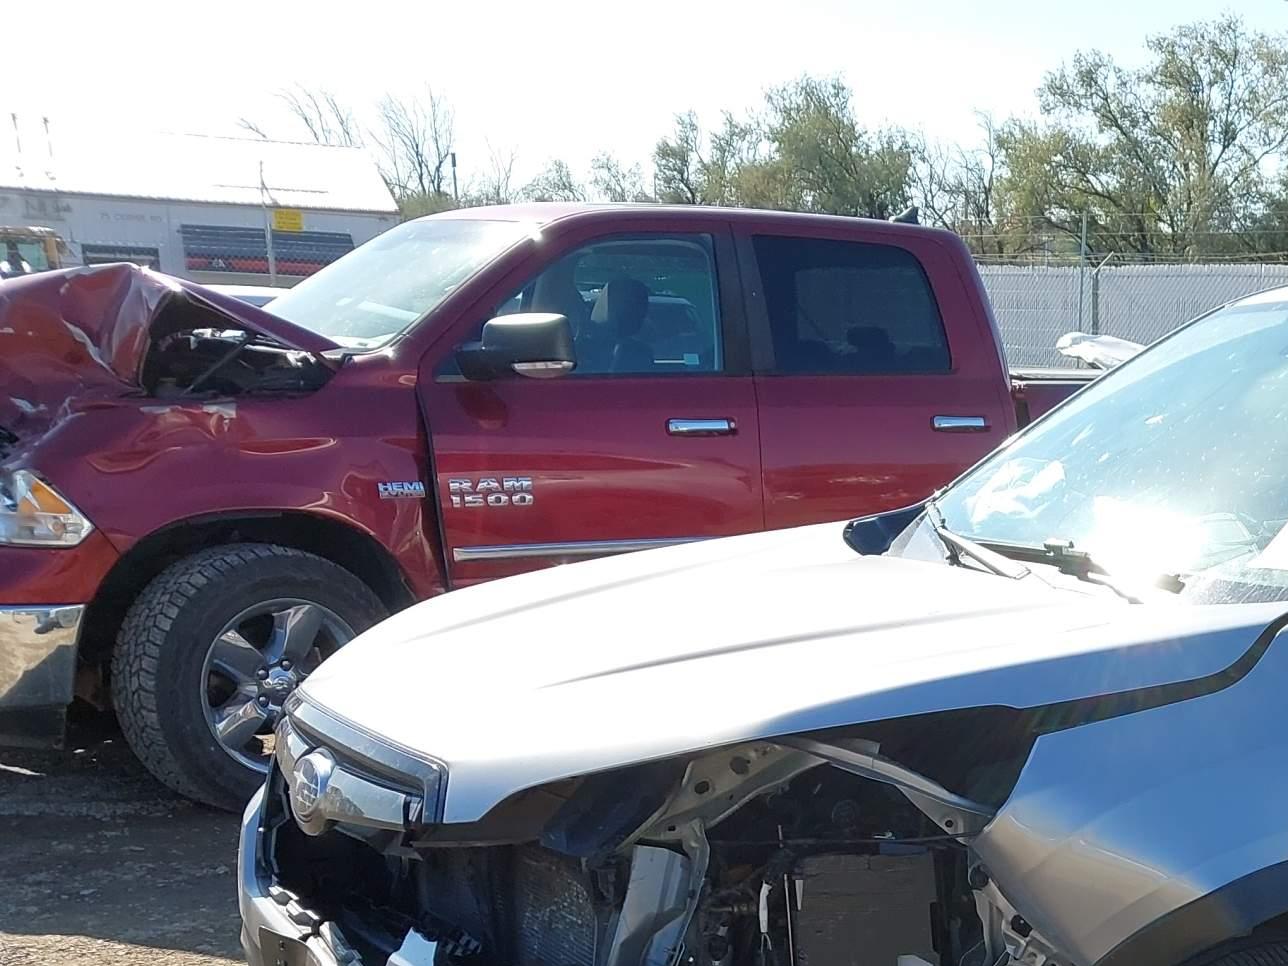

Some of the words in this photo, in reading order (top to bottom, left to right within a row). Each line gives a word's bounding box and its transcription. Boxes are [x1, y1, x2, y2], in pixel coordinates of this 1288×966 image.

[377, 480, 424, 492] HEMI
[448, 476, 533, 493] RAM
[450, 493, 534, 508] 1500
